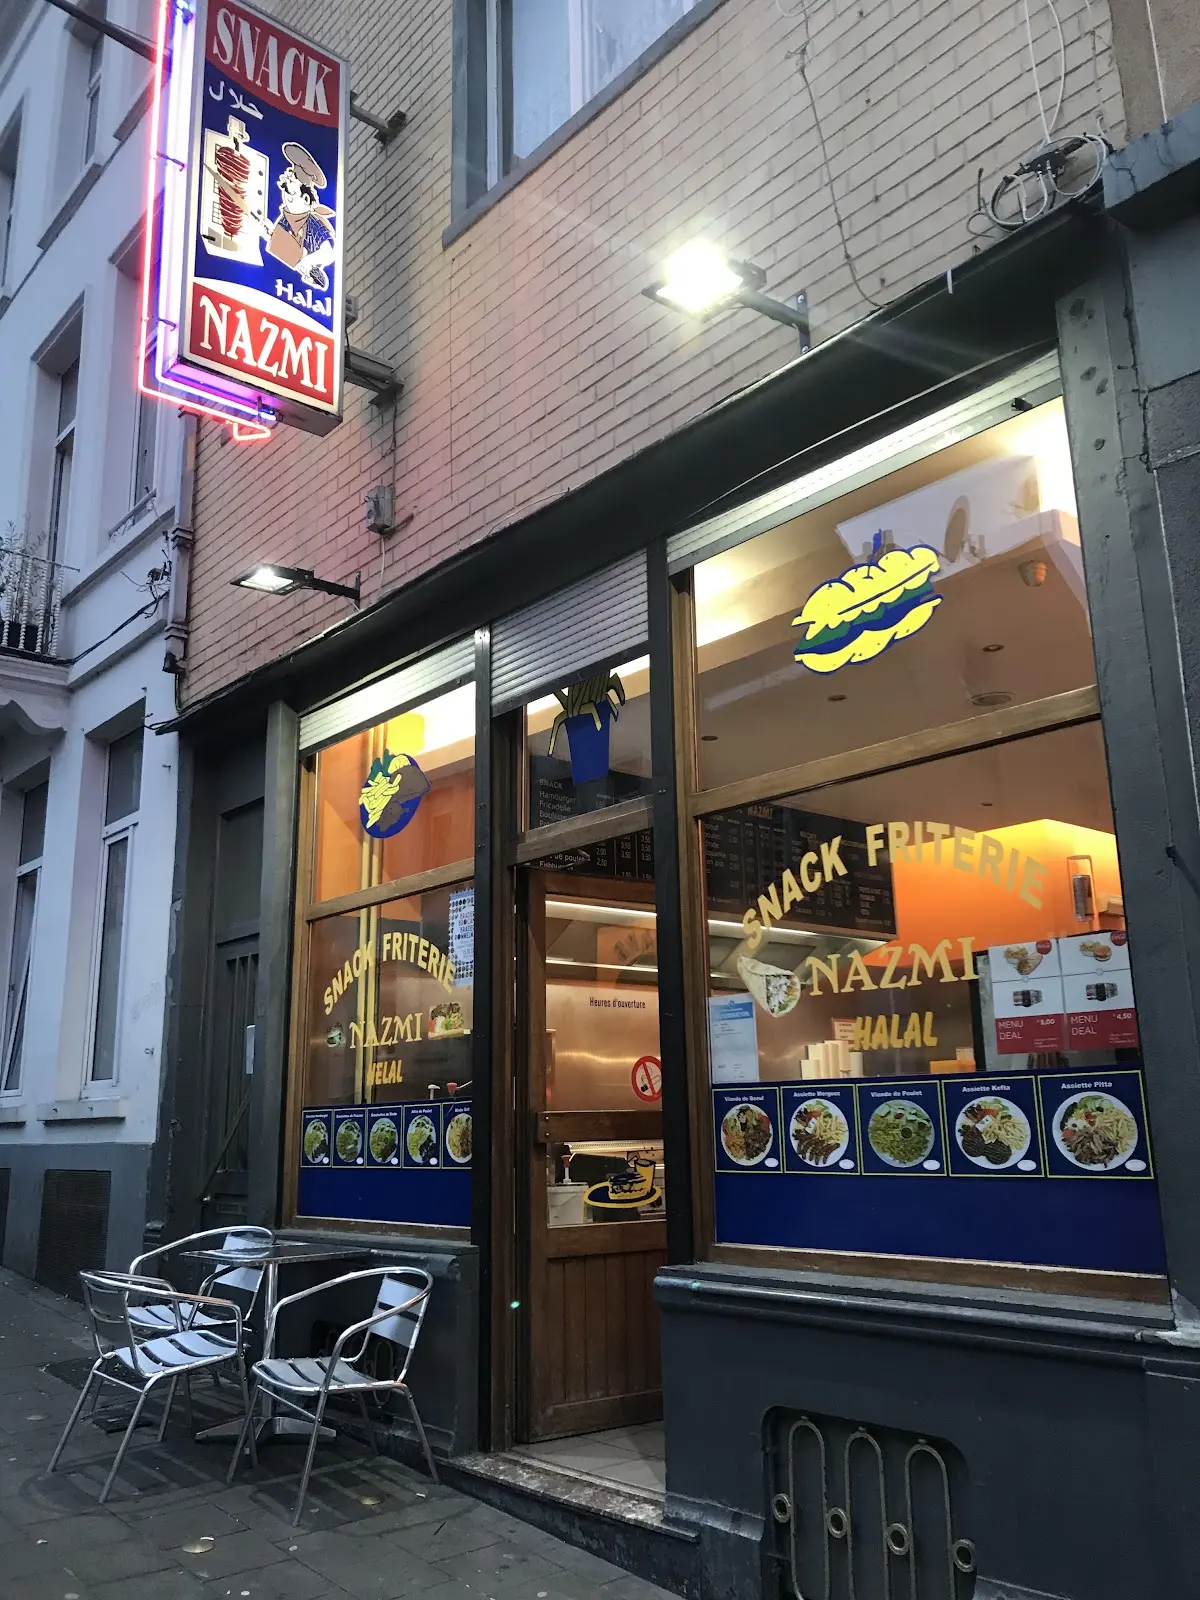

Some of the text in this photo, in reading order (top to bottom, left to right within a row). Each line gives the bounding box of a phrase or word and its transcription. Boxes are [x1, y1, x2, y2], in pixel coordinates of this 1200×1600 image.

[213, 6, 332, 116] SNACK
[208, 81, 264, 120] حلال
[274, 278, 332, 317] Halal
[200, 294, 329, 394] NAZMI
[539, 790, 576, 804] Hamburger
[743, 835, 848, 949] SNACK
[866, 821, 1047, 910] FRITERIE
[323, 932, 457, 1015] SNACK FRITERIE
[805, 936, 980, 996] NAZMI
[589, 997, 646, 1009] Heures d'ouverture
[349, 1012, 423, 1049] NAZMI
[853, 1011, 938, 1050] HALAL
[998, 1020, 1024, 1029] MENU
[1070, 1015, 1098, 1024] MENU
[1071, 1027, 1097, 1036] DEAL
[999, 1031, 1023, 1040] DEAL
[365, 1059, 404, 1085] HELAL
[1061, 1080, 1113, 1089] Assiette Pitta
[962, 1084, 1011, 1093] Assiette Kefta
